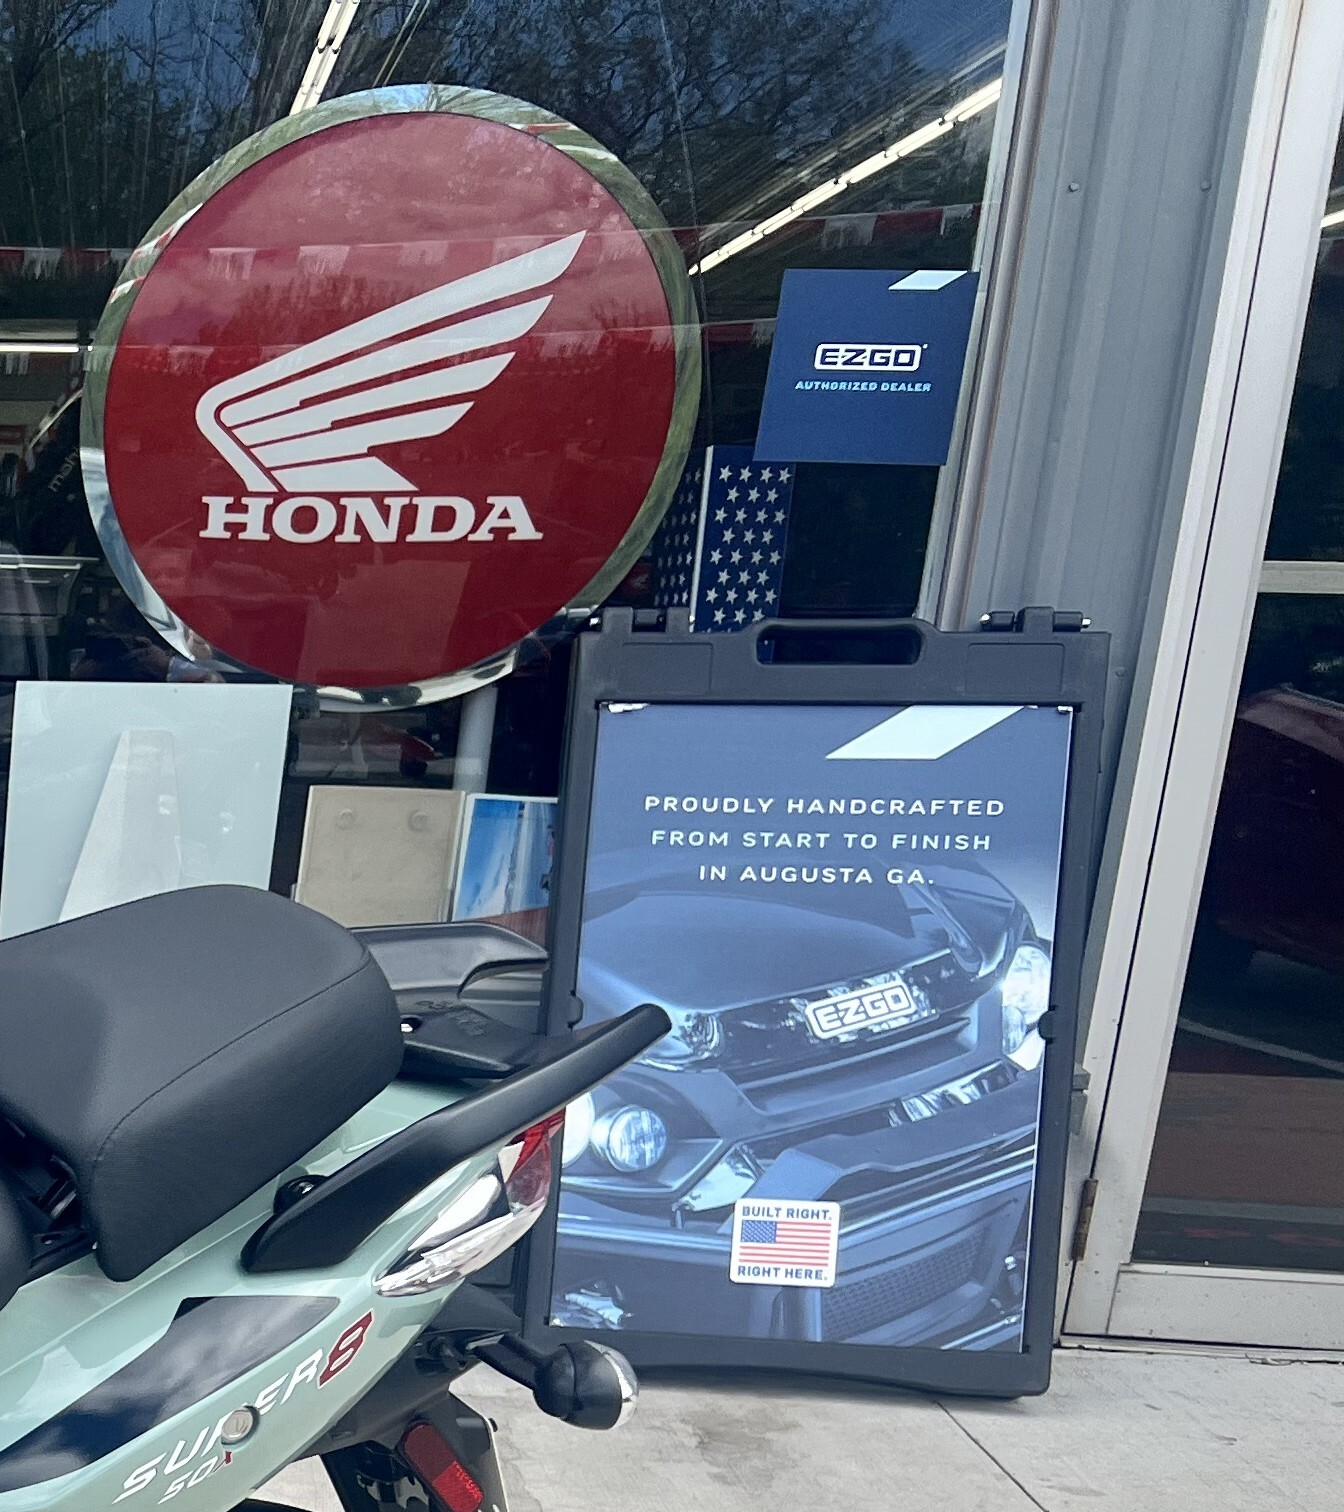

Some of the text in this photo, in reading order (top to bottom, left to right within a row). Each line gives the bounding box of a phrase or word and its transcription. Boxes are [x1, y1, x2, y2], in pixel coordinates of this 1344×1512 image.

[795, 380, 932, 392] AUTHORIZED DEALER
[198, 495, 544, 544] HONDA
[644, 795, 1005, 816] PROUDLY HANDCRAFTED
[651, 829, 991, 851] FROM START TO FINISH
[699, 864, 935, 885] IN AUGUSTA GA.
[741, 1205, 833, 1221] BUILT RIGHT.
[737, 1265, 828, 1281] RIGHT HERE.
